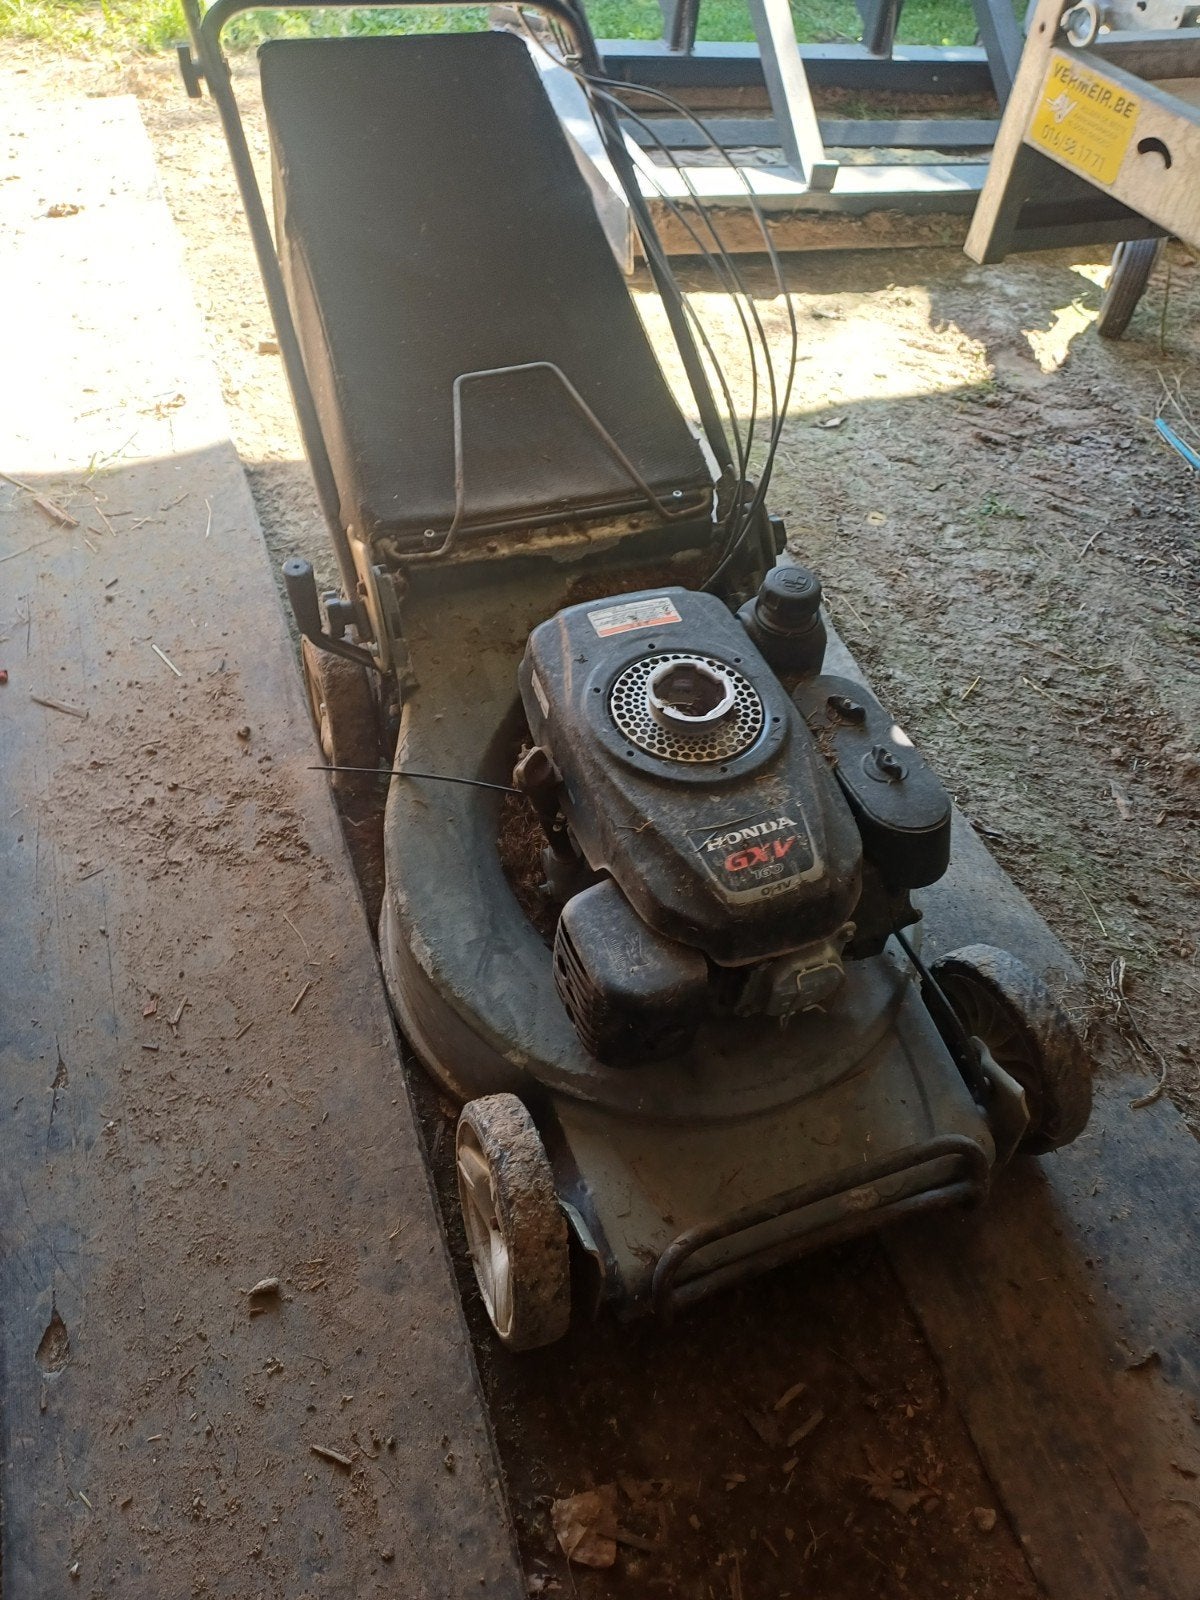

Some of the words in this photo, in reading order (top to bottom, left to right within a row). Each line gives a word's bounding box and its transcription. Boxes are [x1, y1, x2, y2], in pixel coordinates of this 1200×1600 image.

[706, 816, 798, 852] HONDA
[724, 835, 797, 872] GXV
[751, 862, 785, 880] 160
